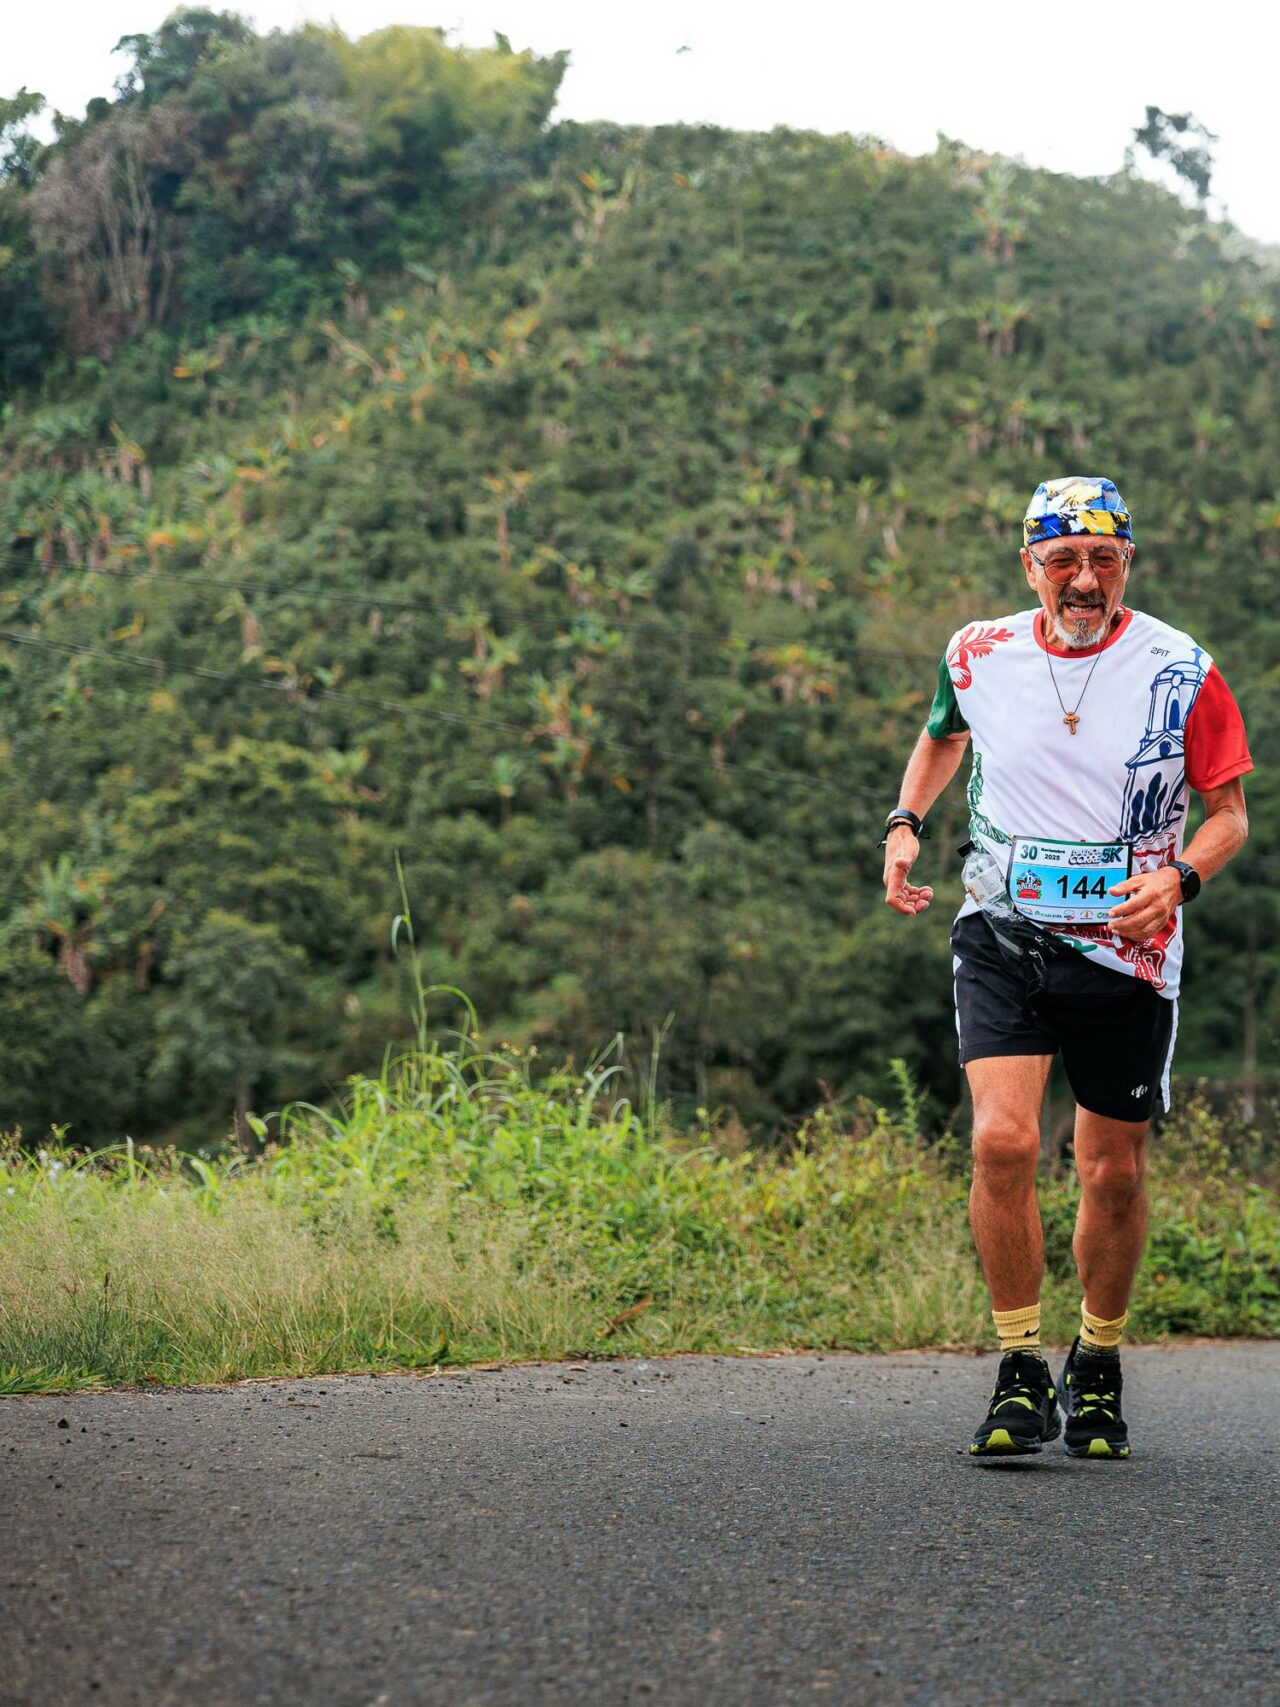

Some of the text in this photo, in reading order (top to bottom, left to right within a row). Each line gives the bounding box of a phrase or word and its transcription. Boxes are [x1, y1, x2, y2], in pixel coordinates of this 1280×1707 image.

[1020, 844, 1038, 861] 30
[1044, 853, 1061, 861] 2025
[1069, 855, 1102, 865] CORRE
[1101, 846, 1125, 863] 5K
[1056, 874, 1108, 899] 144
